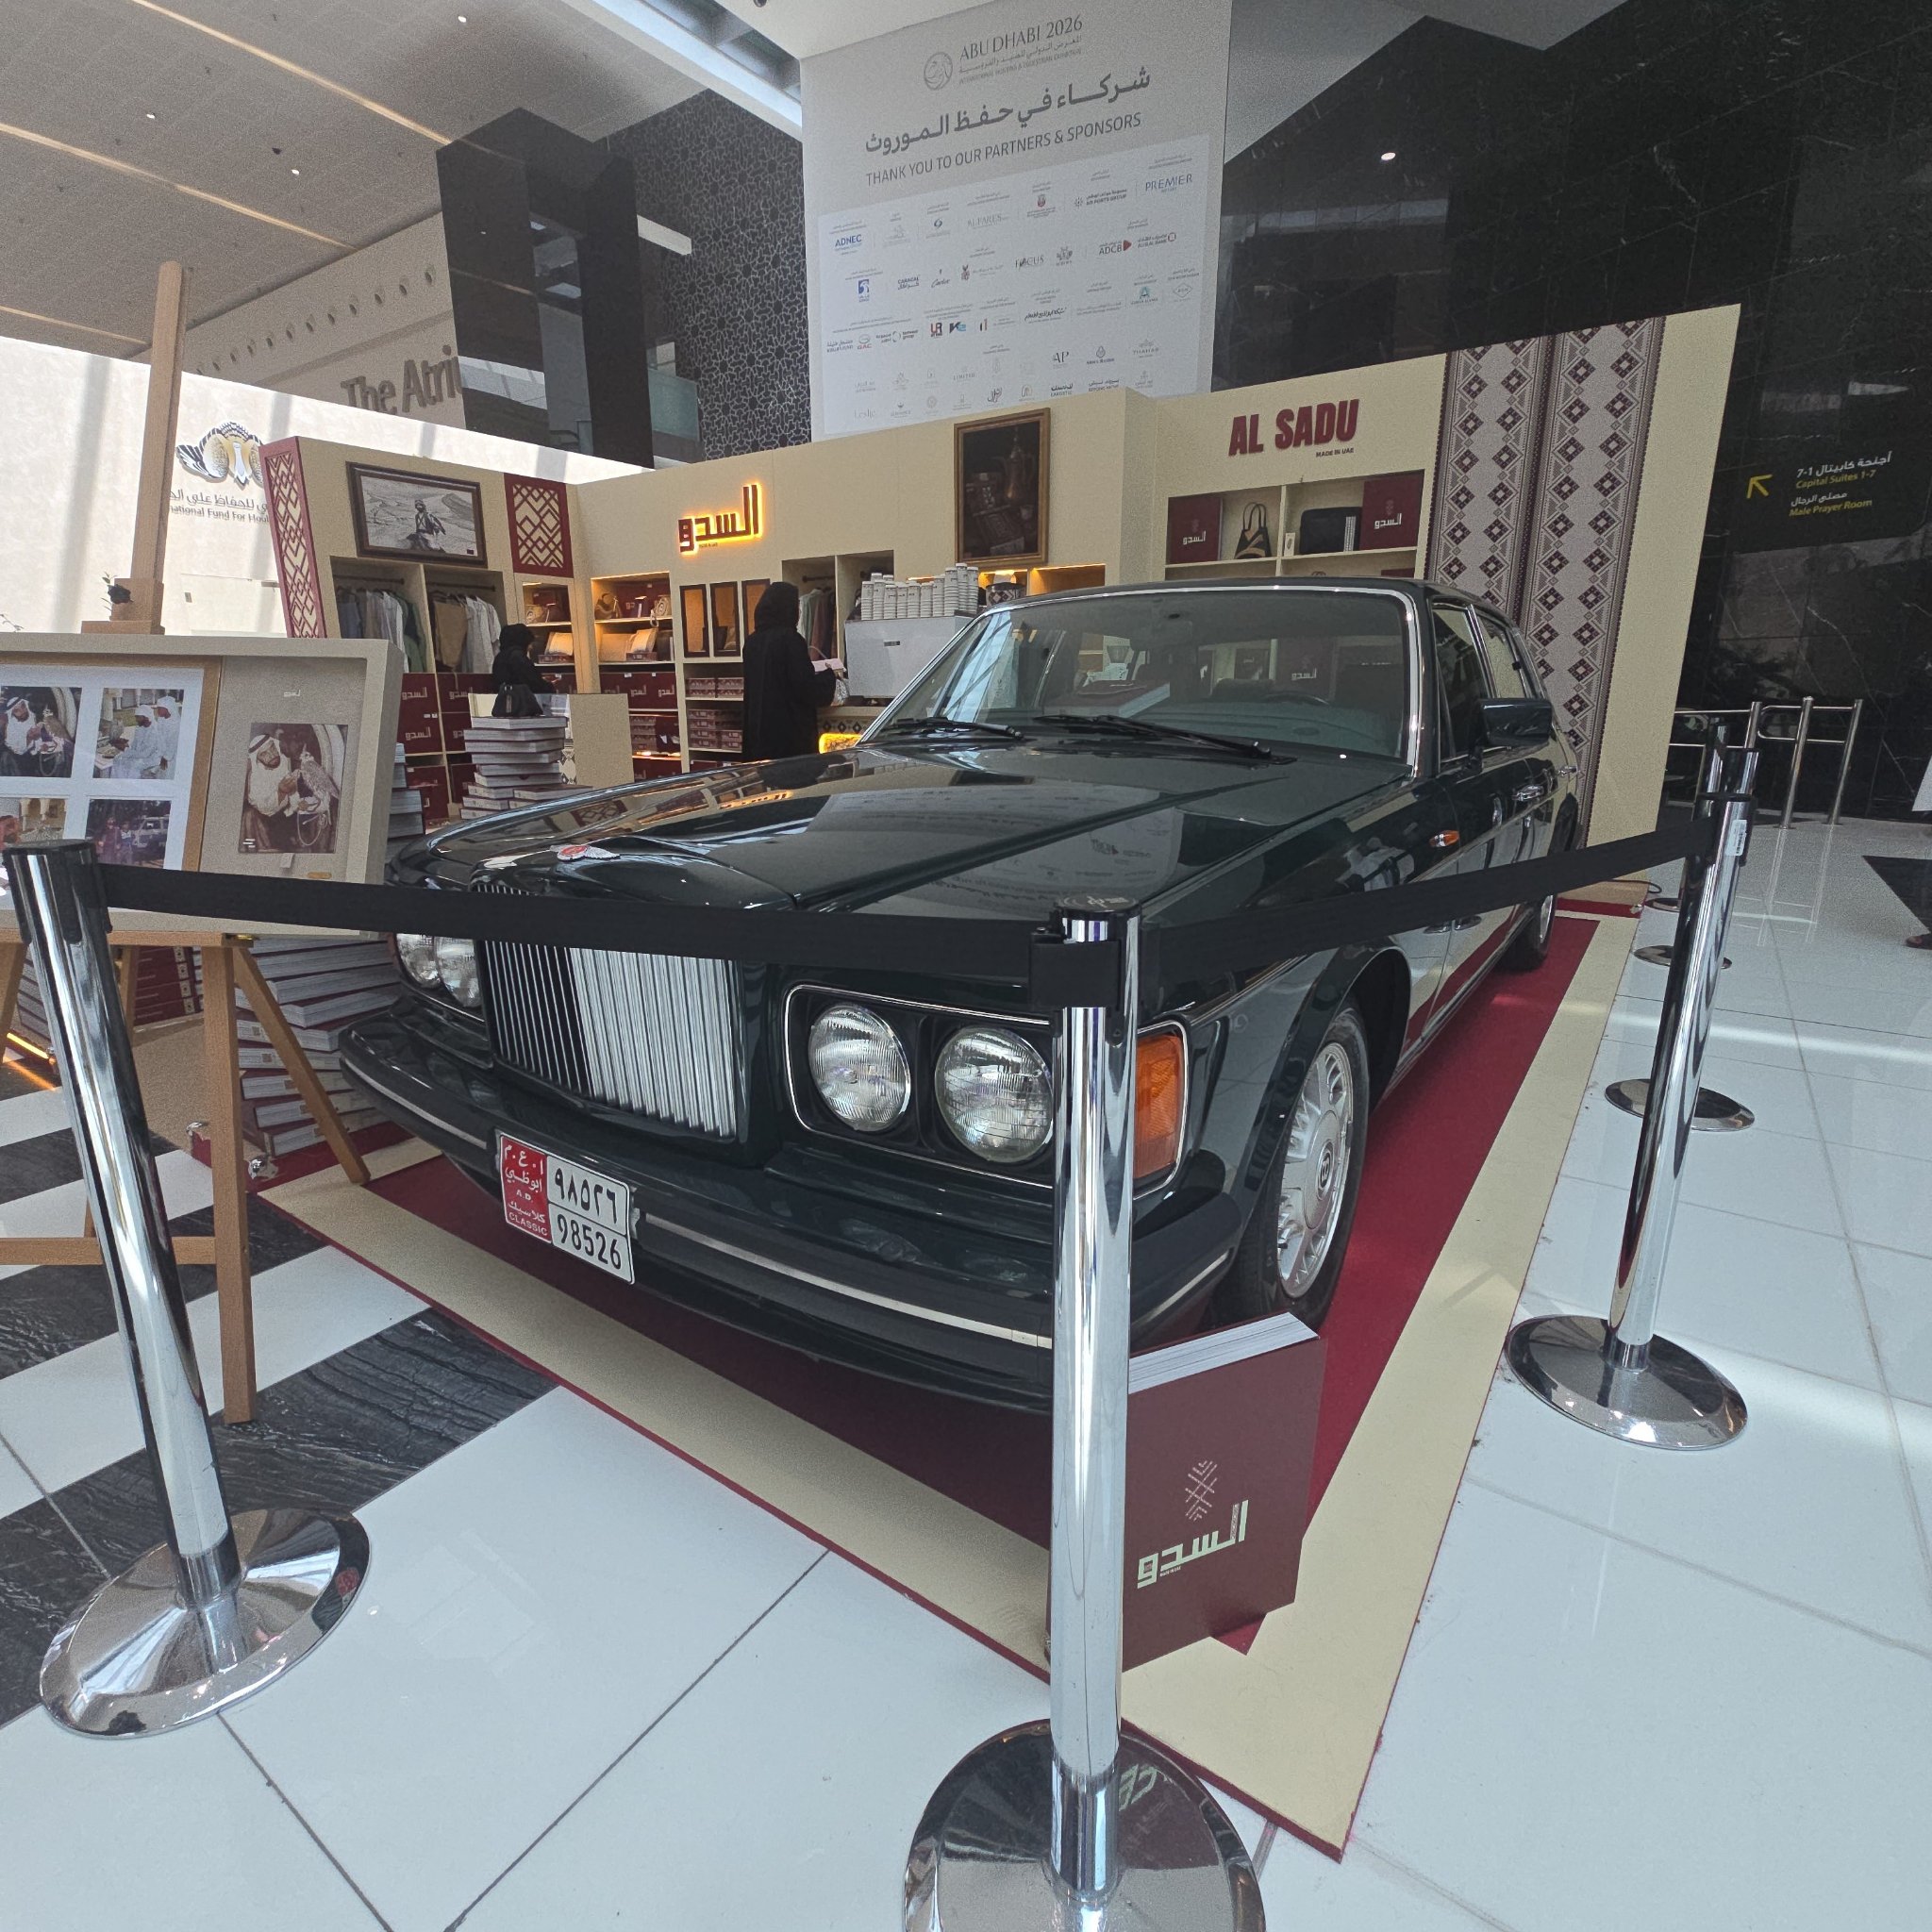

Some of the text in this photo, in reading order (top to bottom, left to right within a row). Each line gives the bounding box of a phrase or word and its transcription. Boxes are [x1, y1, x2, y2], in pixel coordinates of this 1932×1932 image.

[959, 14, 1082, 61] ABU DHABI 2026
[866, 66, 1150, 156] شركاء في حفظ الموروث
[866, 111, 1142, 187] THANK YOU TO OUR PARTNERS & SPONSORS
[1145, 173, 1193, 192] PREMIER
[835, 234, 862, 247] ADNEC
[1099, 244, 1123, 255] ADCB
[341, 375, 397, 416] The
[1228, 399, 1359, 457] AL SADU
[1316, 449, 1333, 458] MADE
[1857, 450, 1892, 468] أجنحة
[1816, 461, 1856, 477] كابيتال
[1795, 469, 1876, 490] Capital Suites 1-7
[187, 491, 212, 506] على
[1789, 498, 1873, 517] Male Prayer Room
[1790, 494, 1818, 508] الرجال
[207, 508, 229, 521] Fund
[232, 510, 246, 522] For
[677, 484, 759, 553] السدو
[1374, 512, 1402, 529] السدو
[1182, 529, 1207, 544] السدو
[402, 687, 427, 700] السدو
[405, 726, 431, 741] السدو
[555, 1168, 618, 1224] ٩٨٥٢٦
[508, 1200, 546, 1224] كلاسيك
[508, 1211, 548, 1236] CLASSIC
[557, 1214, 622, 1270] 98526
[1137, 1499, 1249, 1589] السدو
